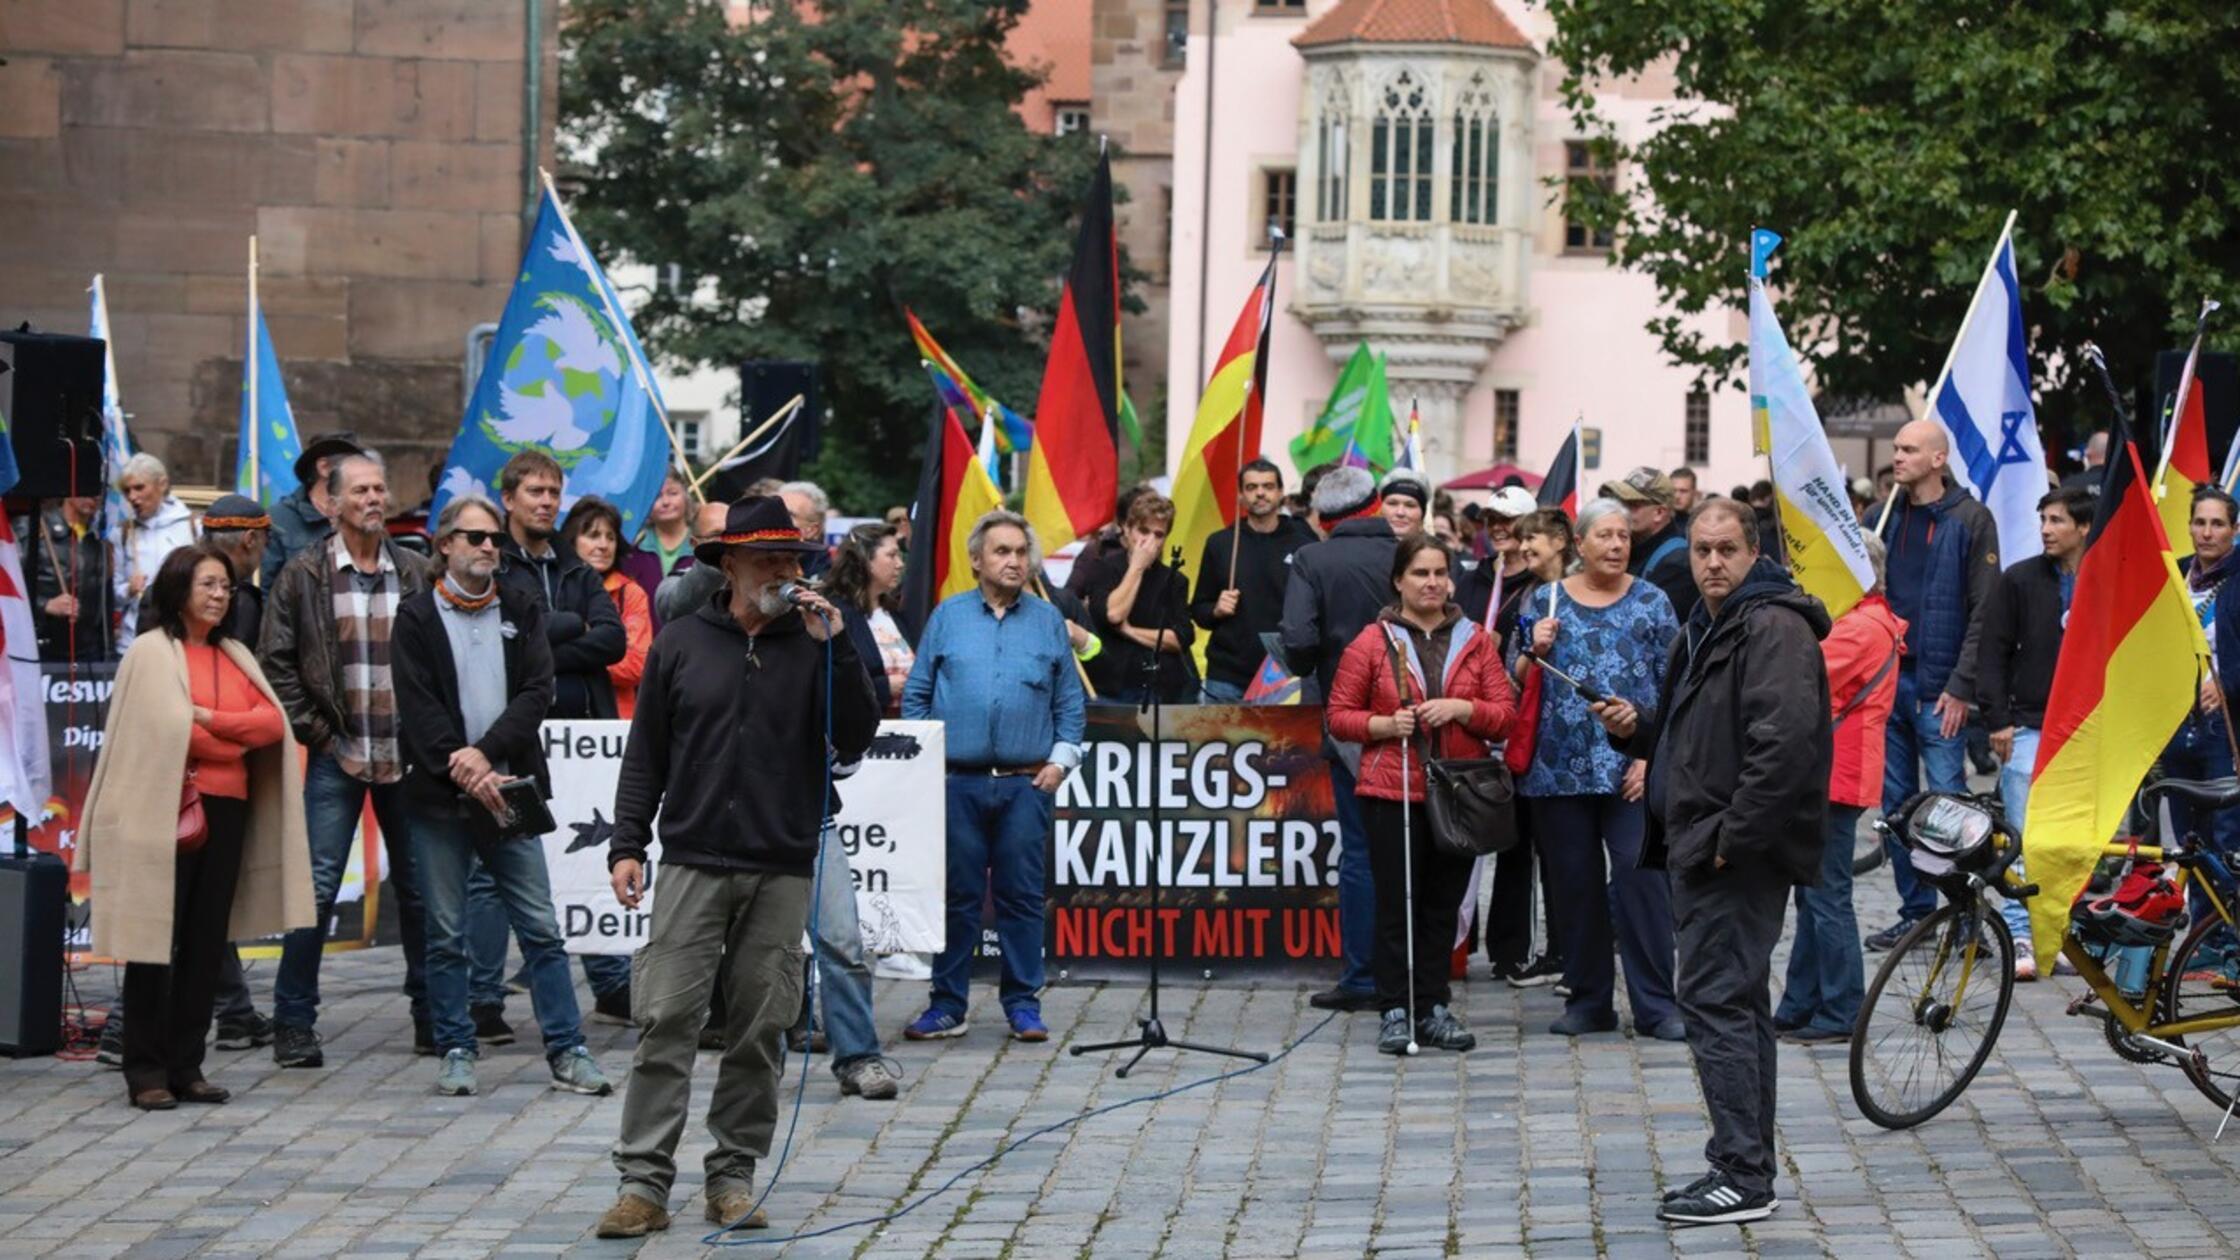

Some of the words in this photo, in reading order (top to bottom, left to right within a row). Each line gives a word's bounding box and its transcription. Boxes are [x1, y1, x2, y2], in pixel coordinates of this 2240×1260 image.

[544, 726, 622, 759] Heu
[1055, 742, 1287, 809] KRIEGS-
[1055, 819, 1343, 887] KANZLER?
[1056, 907, 1181, 958] NICHT
[1193, 908, 1271, 958] MIT
